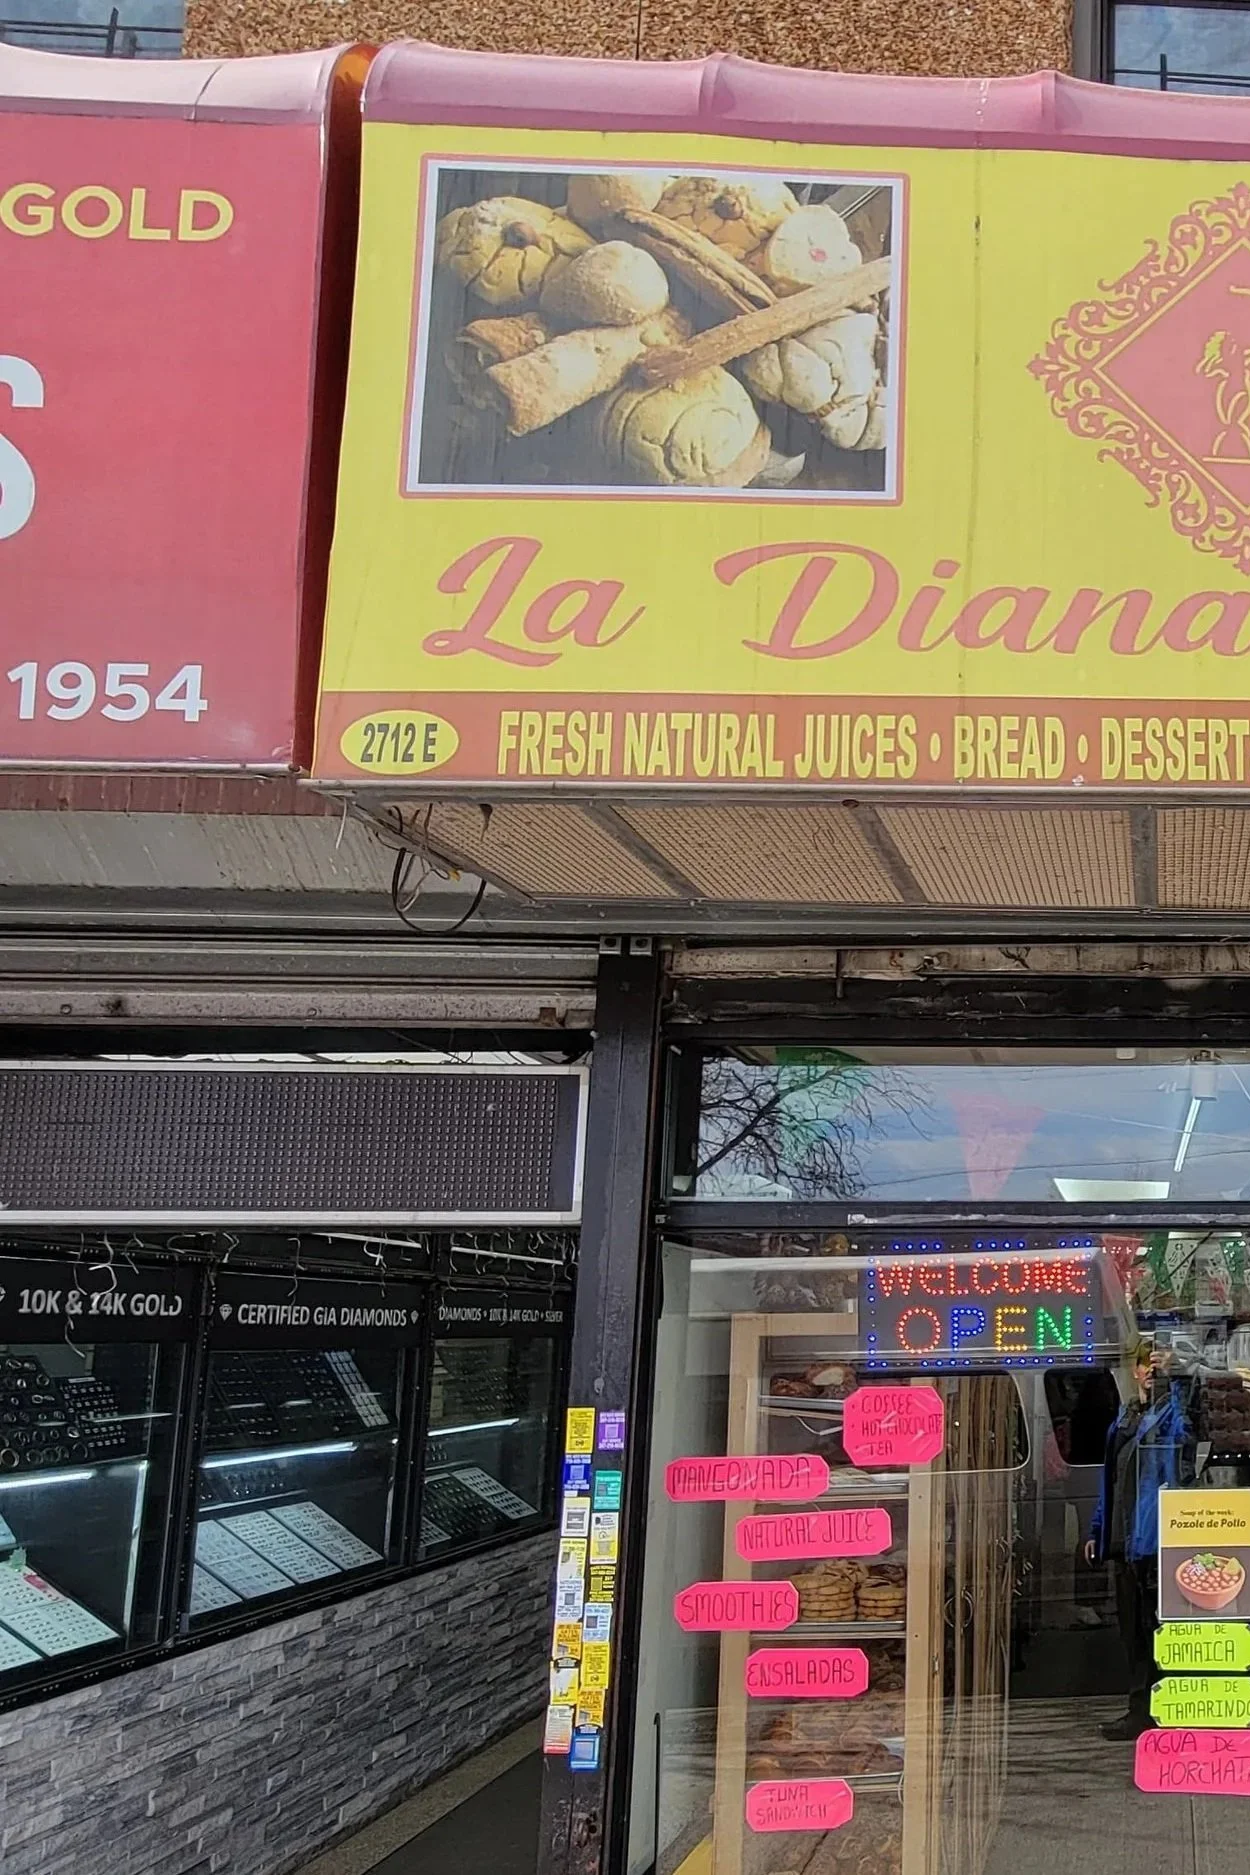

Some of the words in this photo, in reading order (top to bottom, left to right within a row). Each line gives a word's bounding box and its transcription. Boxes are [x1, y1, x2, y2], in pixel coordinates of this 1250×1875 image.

[0, 183, 234, 242] GOLD
[421, 536, 646, 668] La
[8, 661, 208, 726] 1954
[360, 721, 416, 764] 2712
[421, 721, 437, 762] E
[497, 710, 613, 776] FRESH
[622, 711, 784, 778] NATURAL
[795, 713, 917, 779] JUICES
[954, 715, 1065, 779] BREAD
[876, 1256, 1088, 1296] WELCOME
[18, 1289, 62, 1314] 10K
[65, 1290, 82, 1315] &
[88, 1292, 127, 1316] 14K
[130, 1293, 182, 1316] GOLD
[237, 1304, 310, 1325] CERTIFIED
[313, 1306, 337, 1326] GIA
[340, 1307, 407, 1327] DIAMONDS
[439, 1306, 481, 1321] DIAMONDS
[521, 1310, 540, 1322] GOLD
[896, 1305, 1073, 1354] OPEN
[867, 1440, 893, 1456] TEA
[672, 1457, 811, 1495] MANGONADA
[743, 1514, 816, 1550] NATURAL
[822, 1512, 876, 1544] JUICE
[1170, 1520, 1204, 1528] Pozole
[1207, 1520, 1219, 1528] de
[1221, 1519, 1246, 1527] Pollo
[680, 1591, 795, 1623] SMOOTHIES
[1169, 1624, 1202, 1636] AGUA
[1214, 1624, 1227, 1634] DE
[1161, 1640, 1234, 1665] JAMAICA
[747, 1660, 855, 1687] ENSALADAS
[1168, 1679, 1208, 1694] AGUA
[1224, 1680, 1240, 1692] DE
[1144, 1731, 1197, 1754] AGUA
[1210, 1735, 1237, 1753] DE
[764, 1785, 808, 1803] TUNA
